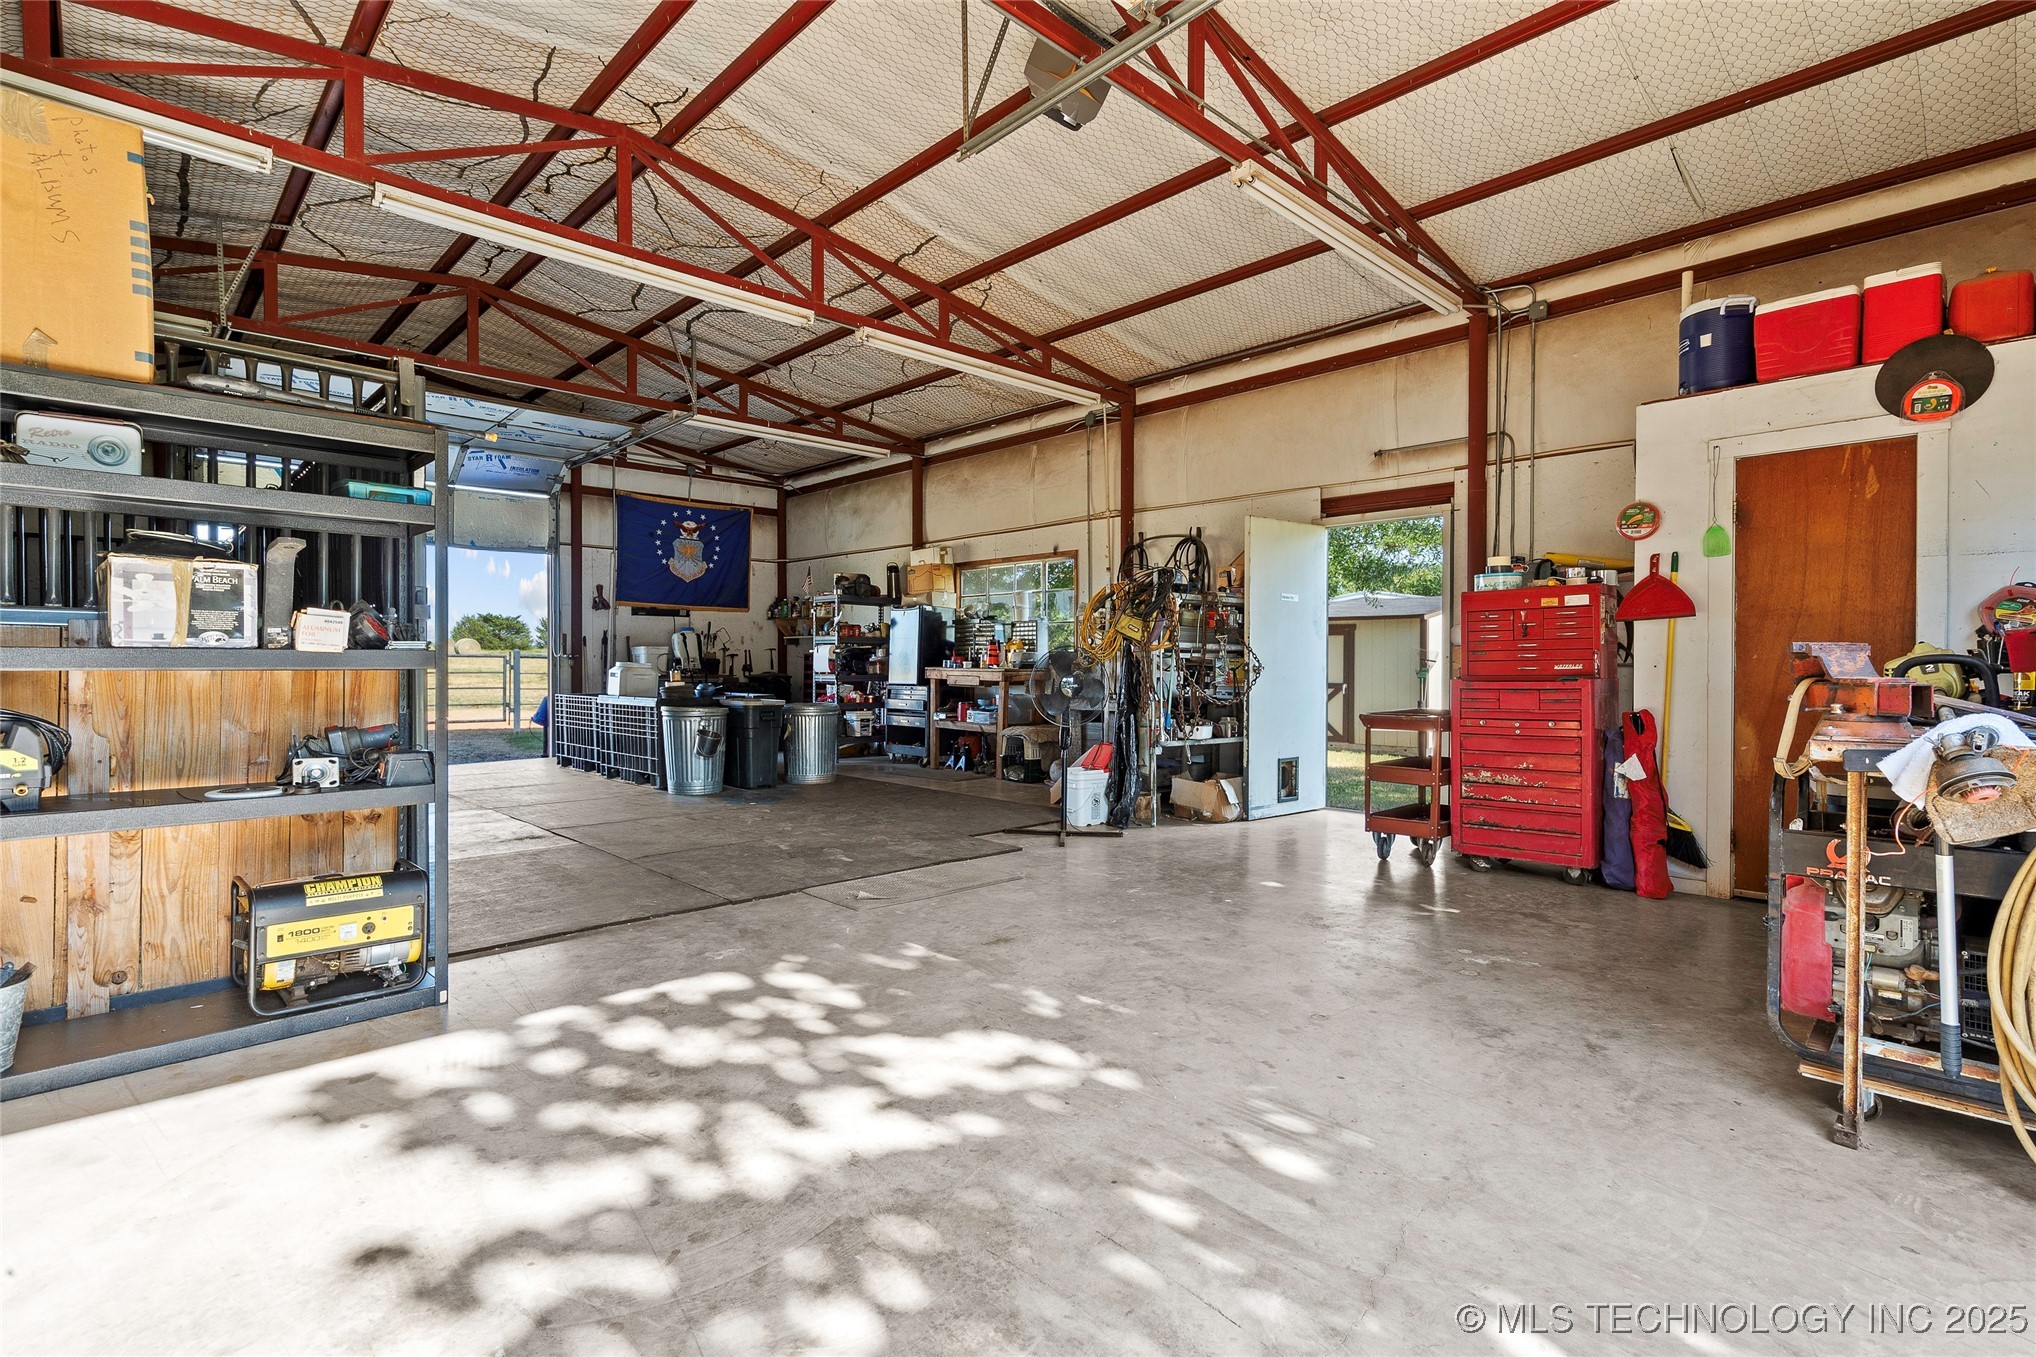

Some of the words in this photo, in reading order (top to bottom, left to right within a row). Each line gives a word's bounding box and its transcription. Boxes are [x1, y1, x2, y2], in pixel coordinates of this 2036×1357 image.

[21, 438, 81, 449] RADIO
[485, 453, 493, 462] R
[212, 575, 238, 585] BEACH
[302, 624, 342, 633] ALUMINUM
[13, 756, 27, 765] 1.2
[1806, 866, 1892, 887] PRAAC
[304, 875, 383, 894] CHAMPION
[288, 927, 321, 938] 1800
